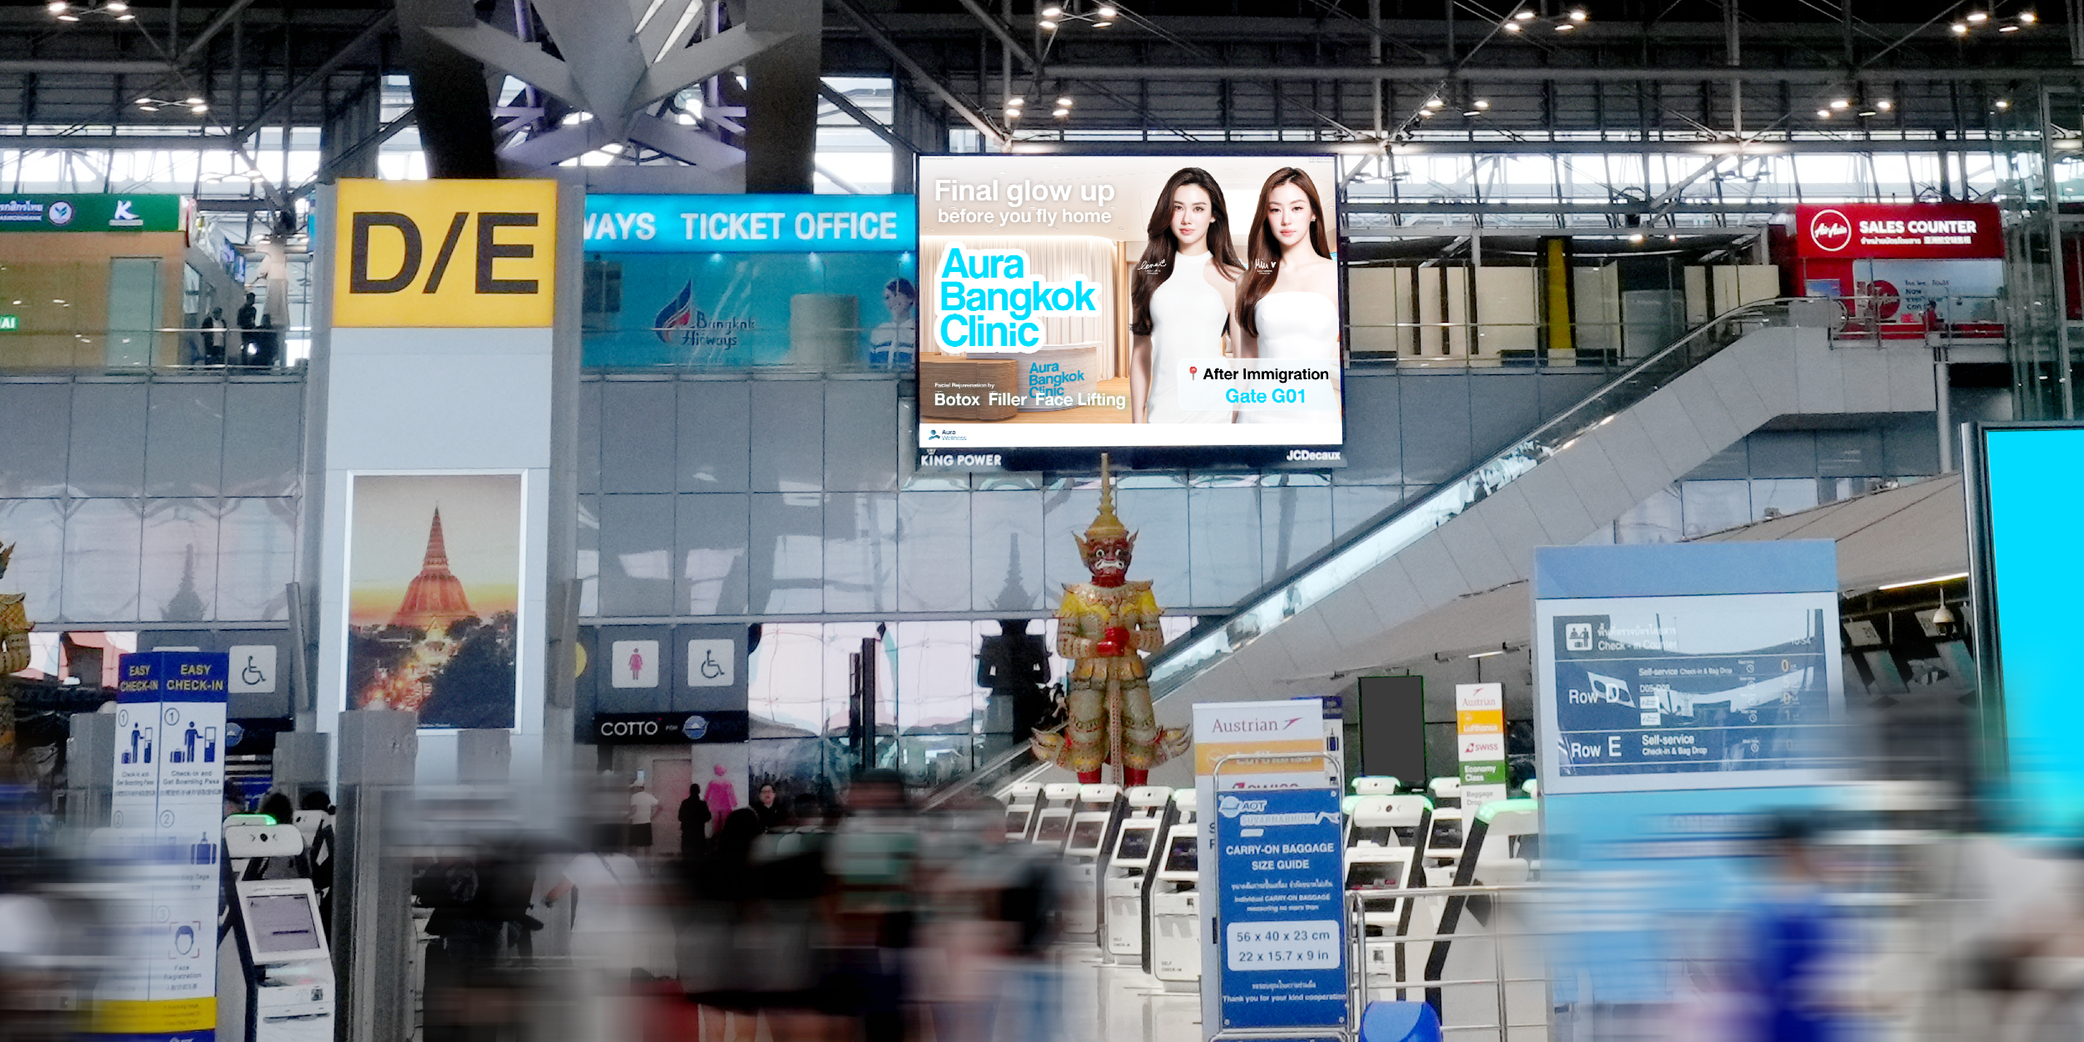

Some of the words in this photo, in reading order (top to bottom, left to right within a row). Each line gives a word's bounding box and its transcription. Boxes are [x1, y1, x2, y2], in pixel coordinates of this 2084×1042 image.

[935, 179, 998, 201] Final
[1006, 179, 1072, 208] glow
[1081, 184, 1115, 207] up
[938, 208, 995, 223] before
[999, 212, 1032, 227] you
[1036, 208, 1058, 227] fly
[1062, 208, 1112, 223] home
[681, 212, 785, 241] TICKET
[794, 212, 897, 241] OFFICE
[1859, 220, 1906, 234] SALES
[1907, 220, 1978, 234] COUNTER
[349, 211, 539, 294] D/E
[941, 248, 1024, 279] Aura
[941, 280, 1096, 321] Bangkok
[697, 310, 756, 335] Bangkok
[940, 313, 1039, 347] Clinic
[682, 330, 737, 351] Airways
[1029, 362, 1060, 374] Aura
[1029, 370, 1085, 387] Bangkok
[1203, 368, 1239, 380] After
[1243, 368, 1329, 384] Immigration
[987, 382, 995, 390] by
[934, 393, 980, 406] Botox
[988, 392, 1027, 406] Filler
[1036, 393, 1073, 406] Face
[1078, 393, 1126, 410] Lifting
[1226, 388, 1267, 404] Gate
[1272, 388, 1305, 404] G01
[920, 454, 954, 466] KING
[957, 454, 1002, 466] POWER
[1286, 450, 1341, 461] JCDecaux
[1597, 640, 1626, 651] Check
[129, 665, 151, 676] EASY
[180, 664, 211, 675] EASY
[120, 680, 159, 692] CHECK-IN
[166, 679, 224, 691] CHECK-IN
[1569, 689, 1600, 704] Row
[1606, 683, 1619, 704] D
[1462, 698, 1496, 707] Austrian
[600, 720, 658, 736] COTTO
[1212, 718, 1279, 733] Austrian
[1463, 724, 1498, 732] Lufthansa
[1571, 743, 1601, 758] Row
[1608, 735, 1622, 757] E
[1641, 735, 1694, 746] Self-service
[1475, 743, 1498, 751] SWISS
[1642, 747, 1670, 756] Check-in
[1678, 747, 1691, 756] Bag
[1692, 746, 1707, 756] Drop
[1464, 765, 1496, 774] Economy
[1464, 773, 1484, 782] Class
[1242, 801, 1266, 811] AOT
[1225, 844, 1280, 855] CARRY-ON
[1282, 843, 1334, 854] BAGGAGE
[1251, 861, 1275, 871] SIZE
[1277, 859, 1310, 870] GUIDE
[1265, 894, 1298, 902] CARRY-ON
[1299, 893, 1331, 901] BAGGAGE
[1237, 931, 1251, 942] 56
[1255, 933, 1261, 942] x
[1265, 930, 1280, 941] 40
[1283, 932, 1290, 941] x
[1293, 930, 1308, 941] 23
[1311, 931, 1330, 940] cm
[1239, 951, 1253, 962] 22
[1257, 953, 1263, 961] x
[1268, 950, 1292, 961] 15.7
[1296, 952, 1303, 961] x
[1306, 950, 1314, 961] 9
[1318, 949, 1329, 960] in
[1245, 995, 1259, 1003] you
[1260, 994, 1269, 1002] for
[1271, 994, 1287, 1003] your
[1288, 993, 1303, 1001] kind
[1304, 992, 1347, 1002] cooperation
